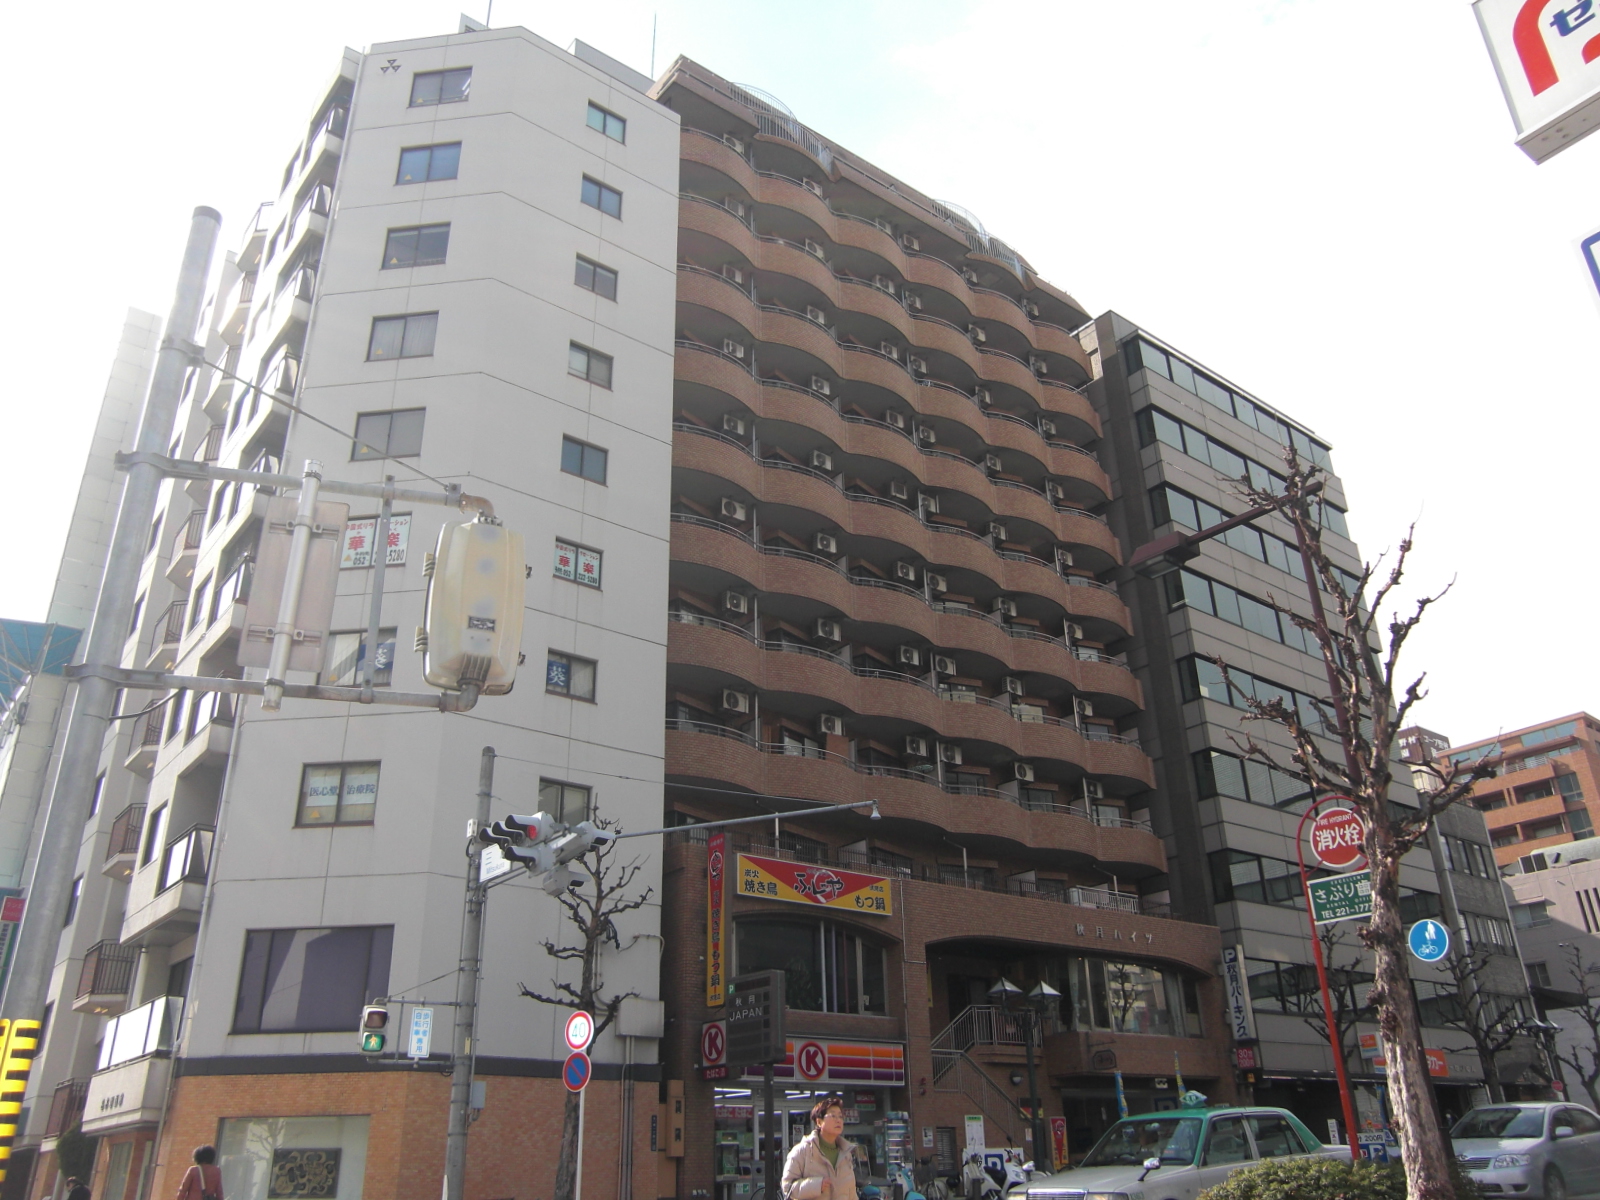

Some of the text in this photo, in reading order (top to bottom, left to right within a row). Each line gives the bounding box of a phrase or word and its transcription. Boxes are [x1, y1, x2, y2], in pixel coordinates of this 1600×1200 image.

[1317, 813, 1352, 826] FIRE HYDRANT
[1315, 822, 1362, 852] 消火栓
[744, 878, 778, 896] 焼き鳥
[1330, 874, 1365, 886] EXCELLENT
[854, 894, 886, 912] もつ鍋
[1326, 900, 1350, 909] DENTAL
[1321, 909, 1335, 919] TEL
[1224, 948, 1236, 962] P
[728, 984, 736, 994] P
[729, 1007, 762, 1021] JAPAN
[571, 1022, 586, 1039] 40
